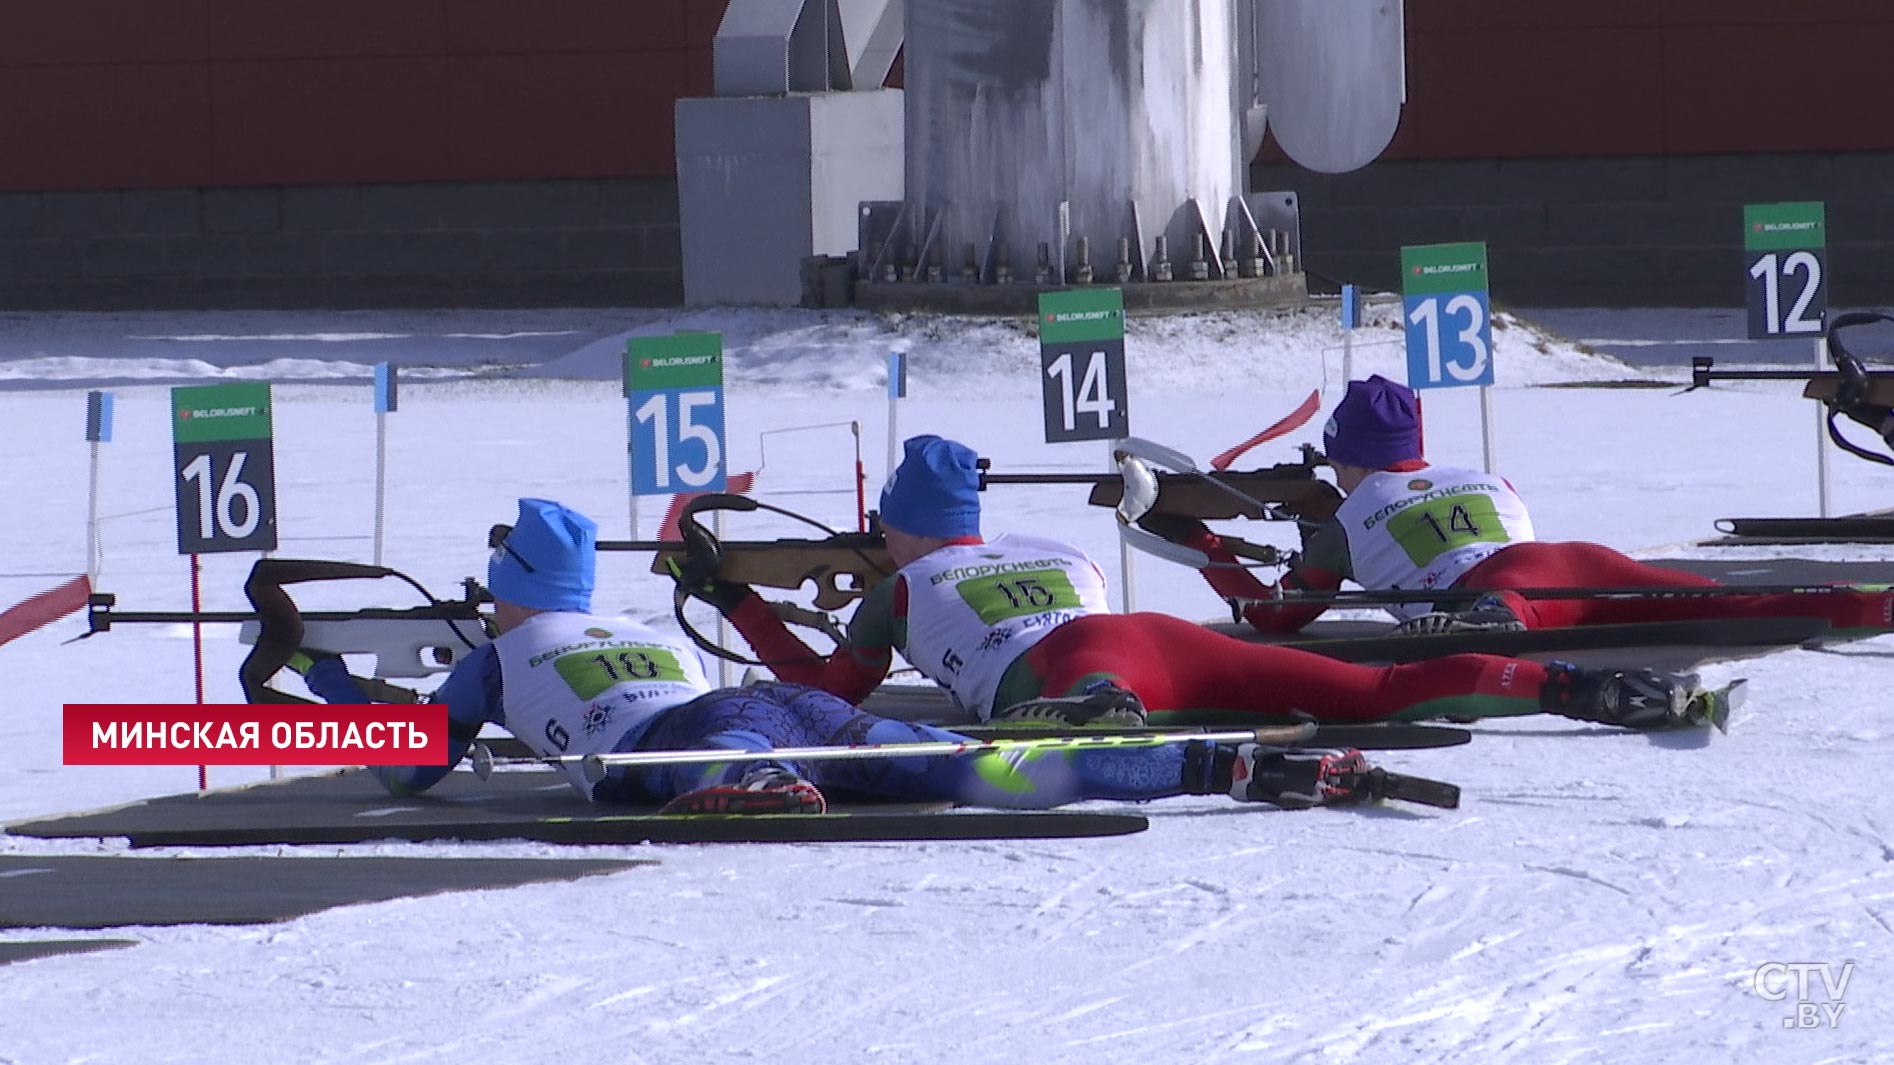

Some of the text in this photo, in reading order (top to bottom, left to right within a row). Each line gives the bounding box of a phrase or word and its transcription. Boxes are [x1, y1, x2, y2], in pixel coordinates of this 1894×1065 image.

[1423, 263, 1478, 275] BELORUSNEFT
[1749, 251, 1823, 334] 12
[1056, 310, 1111, 323] BELORUSNEFT
[1408, 294, 1488, 383] 13
[652, 354, 713, 368] BELORUSNEFT
[1047, 351, 1116, 432] 14
[192, 406, 256, 420] BELORUSNEFT
[635, 391, 721, 488] 15
[181, 451, 261, 540] 16
[1421, 503, 1479, 544] 14
[996, 578, 1055, 609] 15
